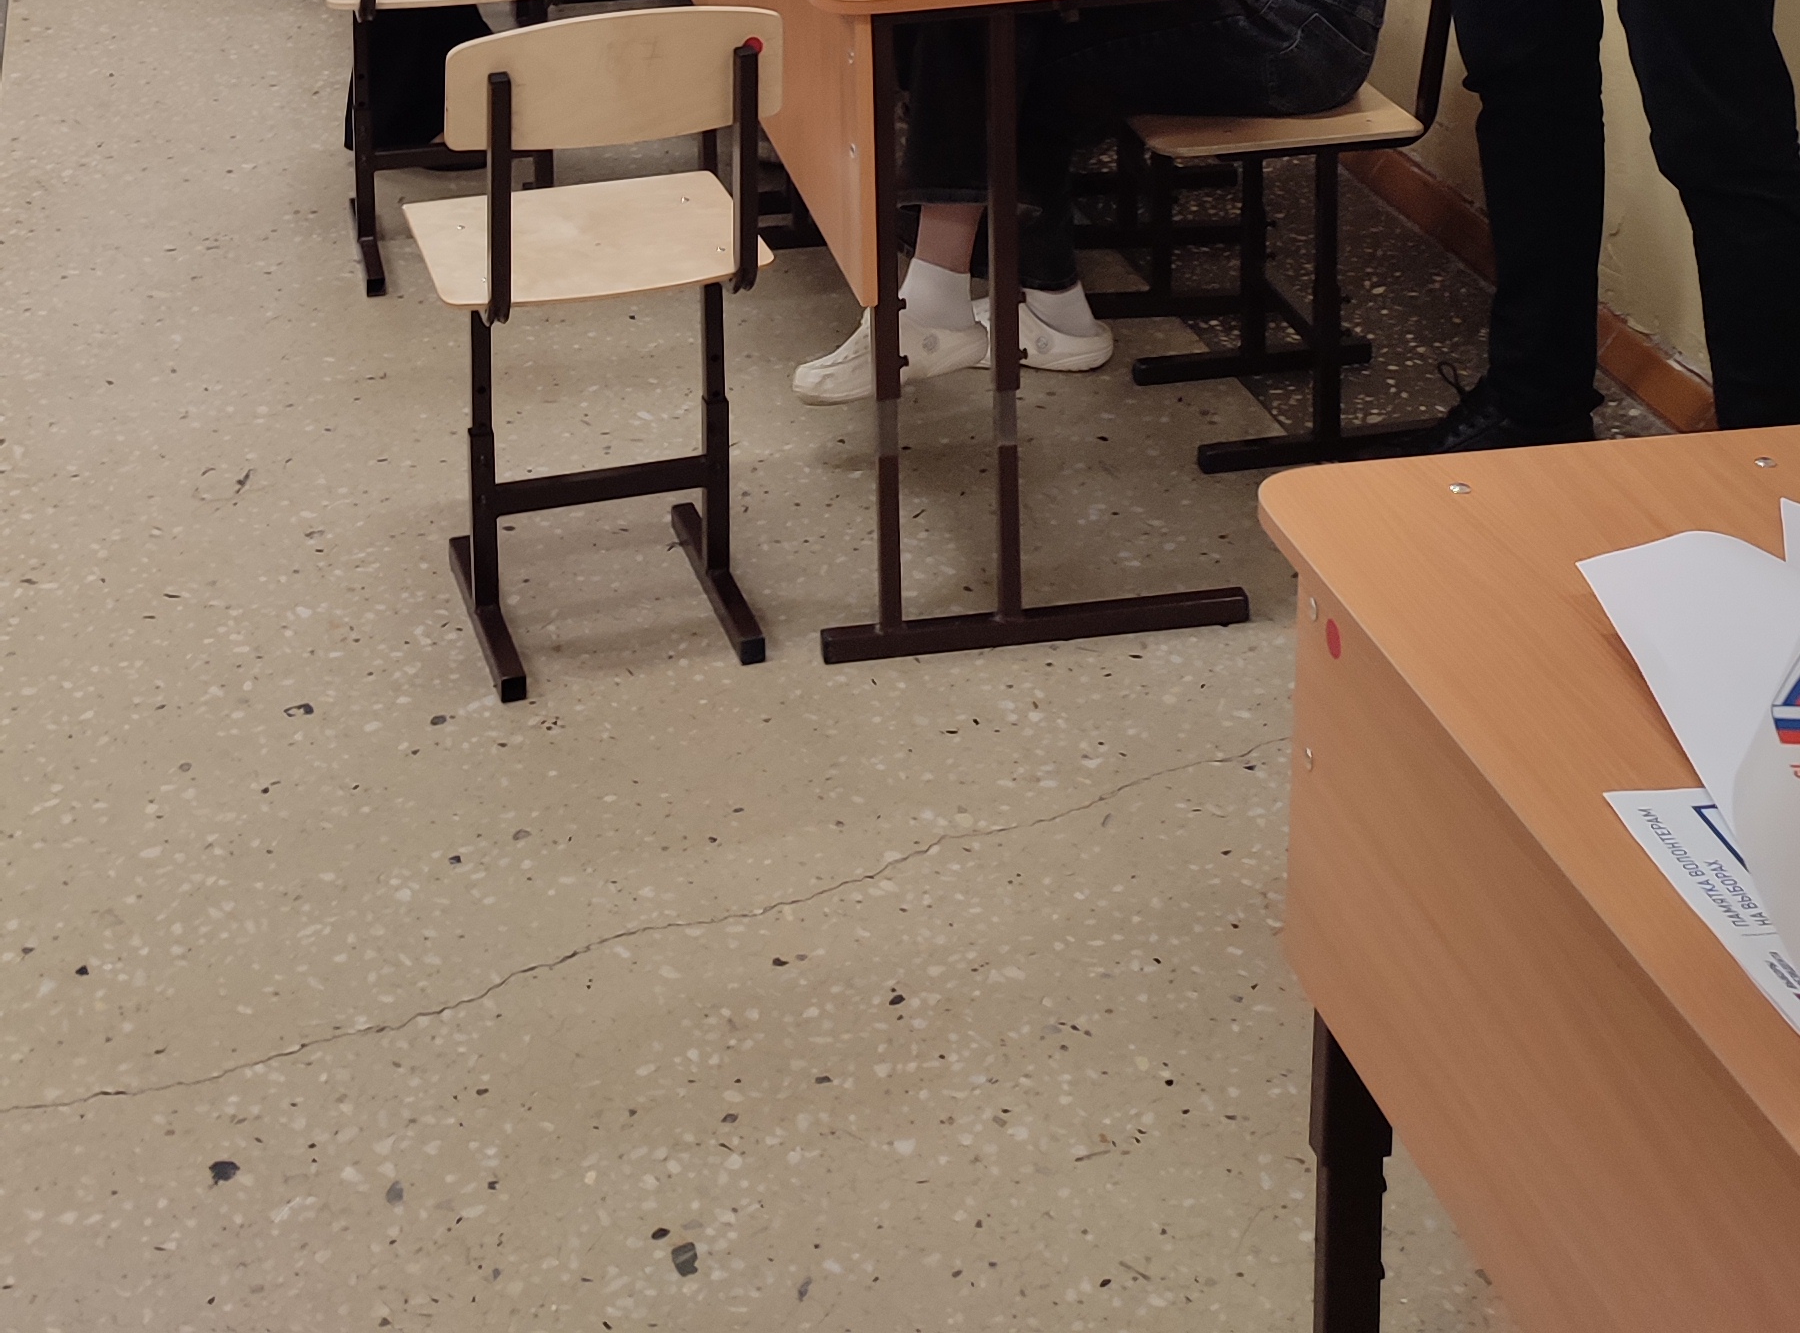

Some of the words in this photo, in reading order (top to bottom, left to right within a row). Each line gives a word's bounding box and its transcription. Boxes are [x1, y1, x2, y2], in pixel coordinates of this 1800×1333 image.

[1637, 808, 1706, 877] ВОЛОНТЕРАМ
[1697, 880, 1750, 927] ПАМЯТКА
[1703, 859, 1759, 910] ВЫБОРАХ
[1749, 912, 1773, 927] НА
